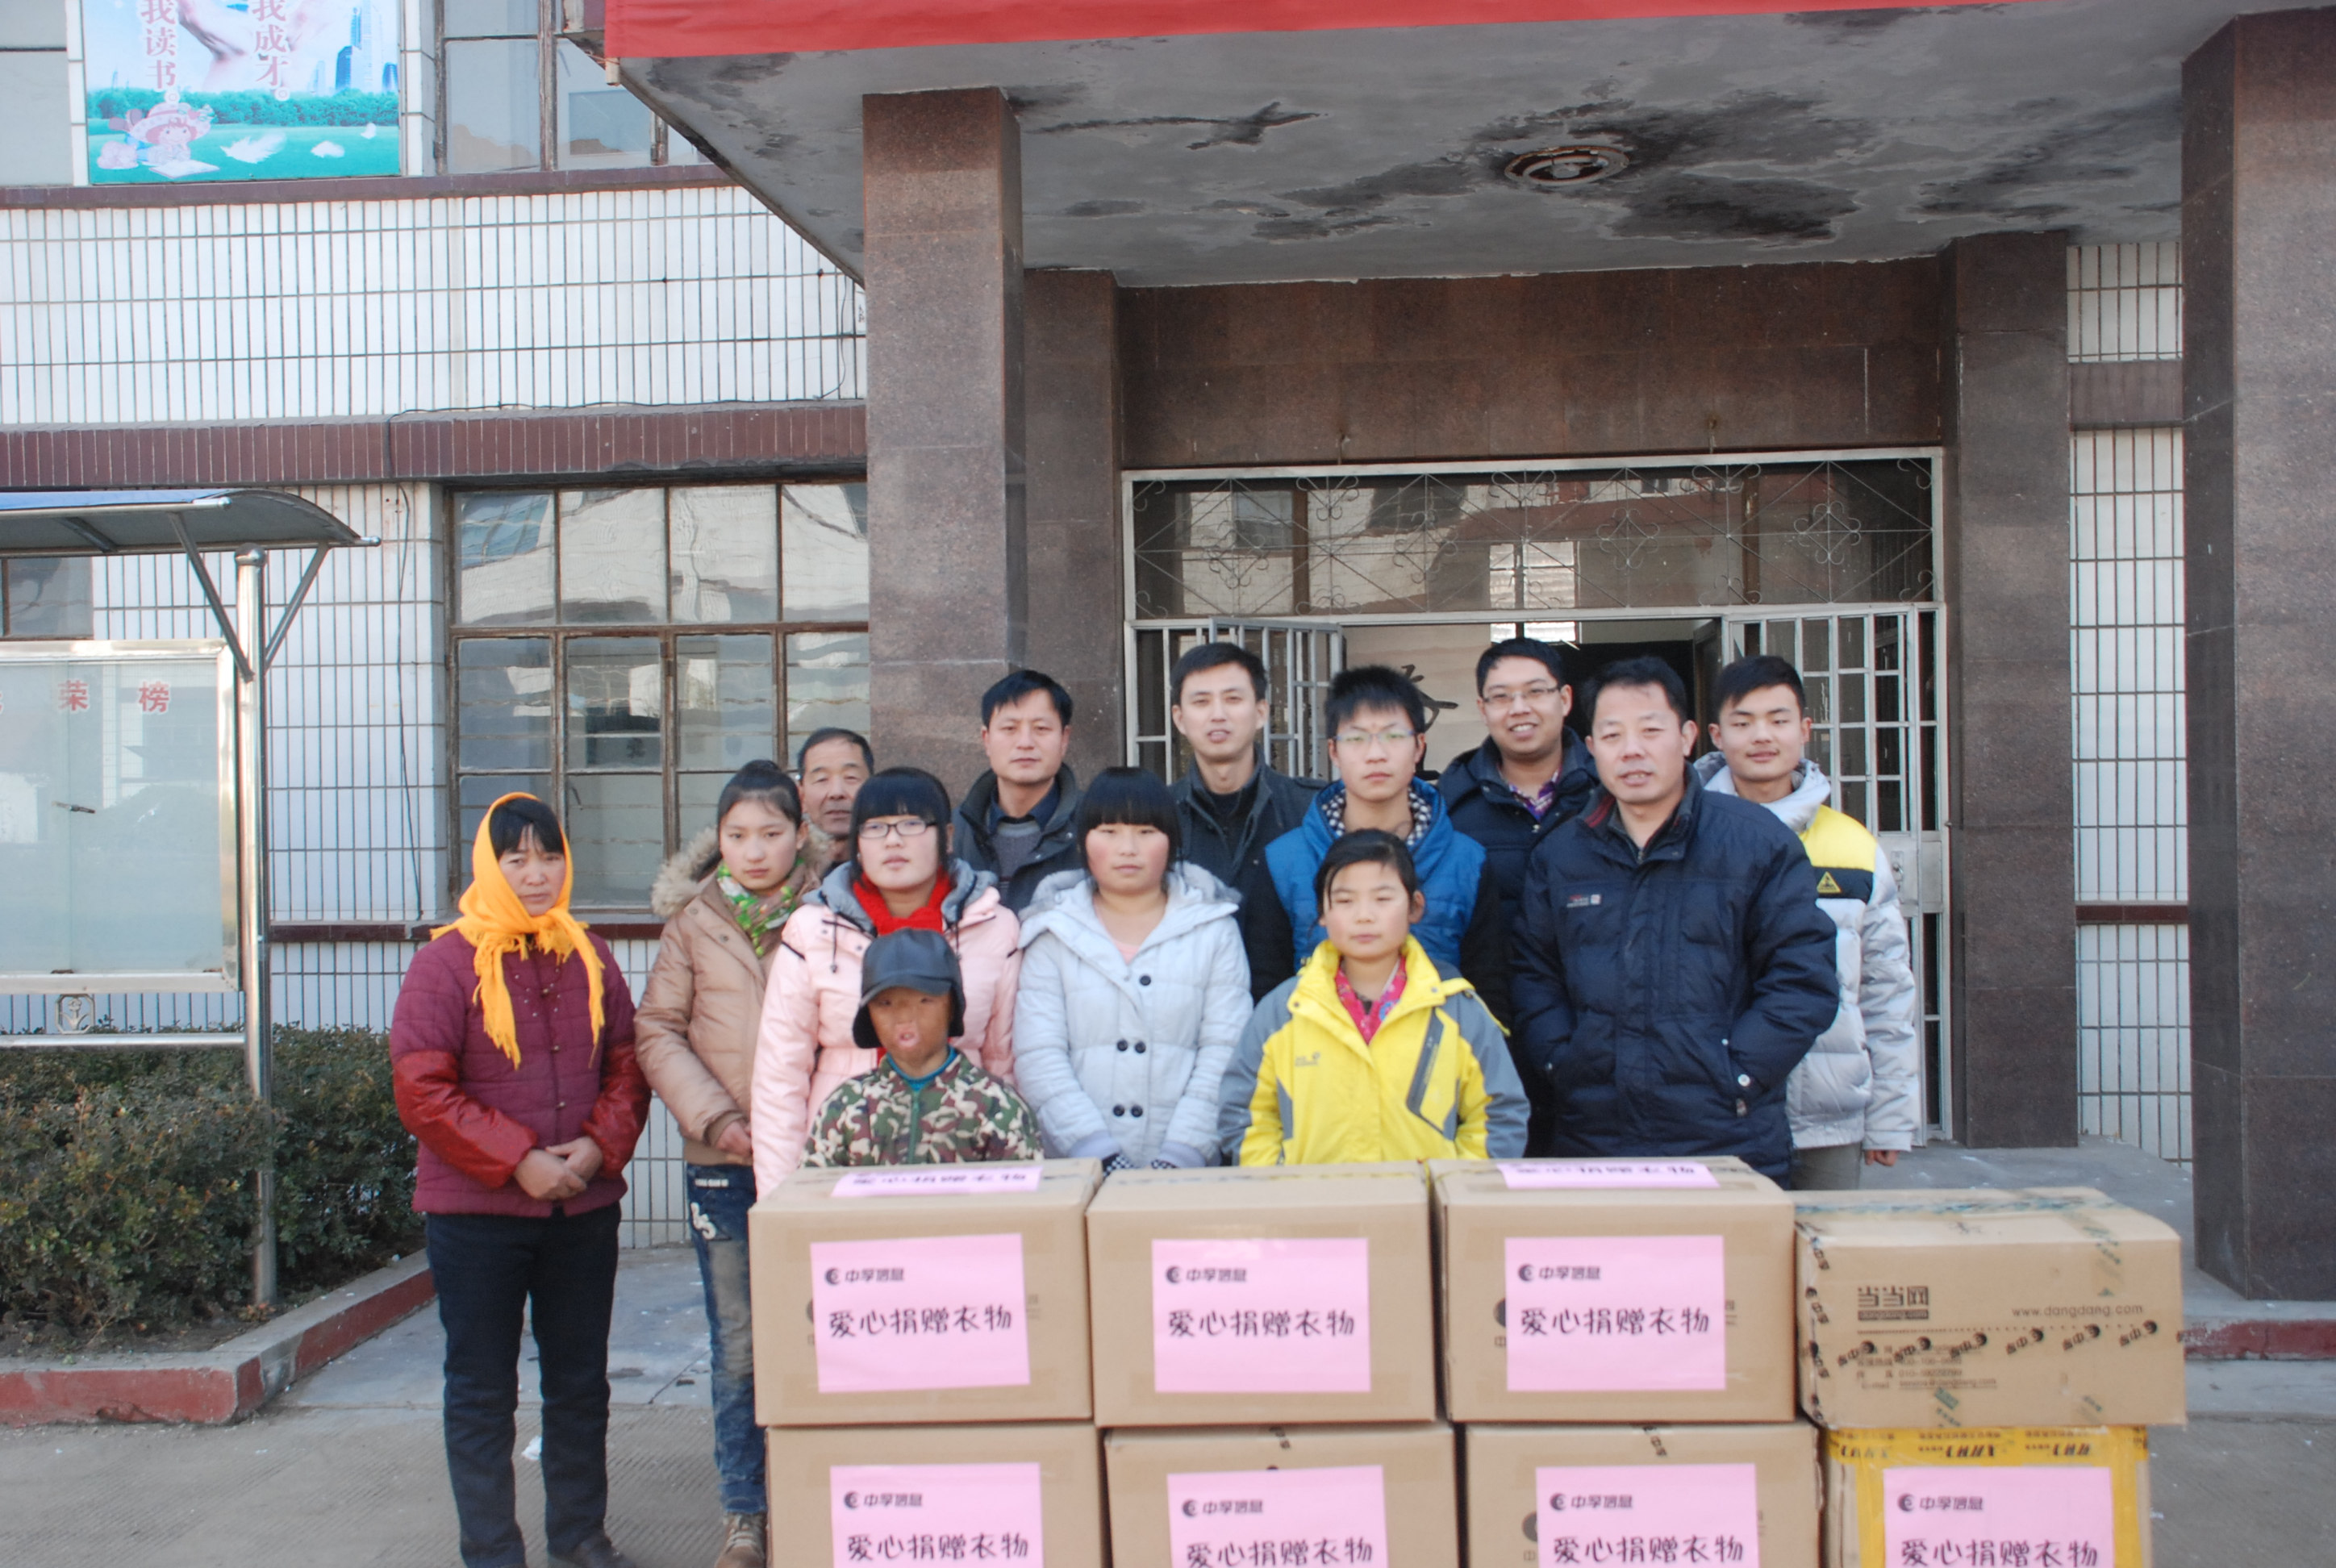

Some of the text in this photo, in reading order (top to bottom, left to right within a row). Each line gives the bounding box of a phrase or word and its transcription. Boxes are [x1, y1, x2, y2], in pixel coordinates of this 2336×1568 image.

[0, 680, 169, 712] 荣榜
[1858, 1284, 1929, 1307] 当当网
[829, 1304, 1012, 1338] 爱心捐赠衣物
[1169, 1308, 1355, 1337] 爱心捐赠衣物
[1520, 1307, 1710, 1335] 爱心捐赠衣物
[2012, 1304, 2143, 1318] www.dangdang.com
[847, 1532, 1028, 1562] 爱心捐赠衣物
[1187, 1537, 1373, 1568] 爱心捐赠衣物
[1554, 1534, 1743, 1564] 爱心捐赠衣物
[1900, 1538, 2098, 1567] 爱心捐赠衣物
